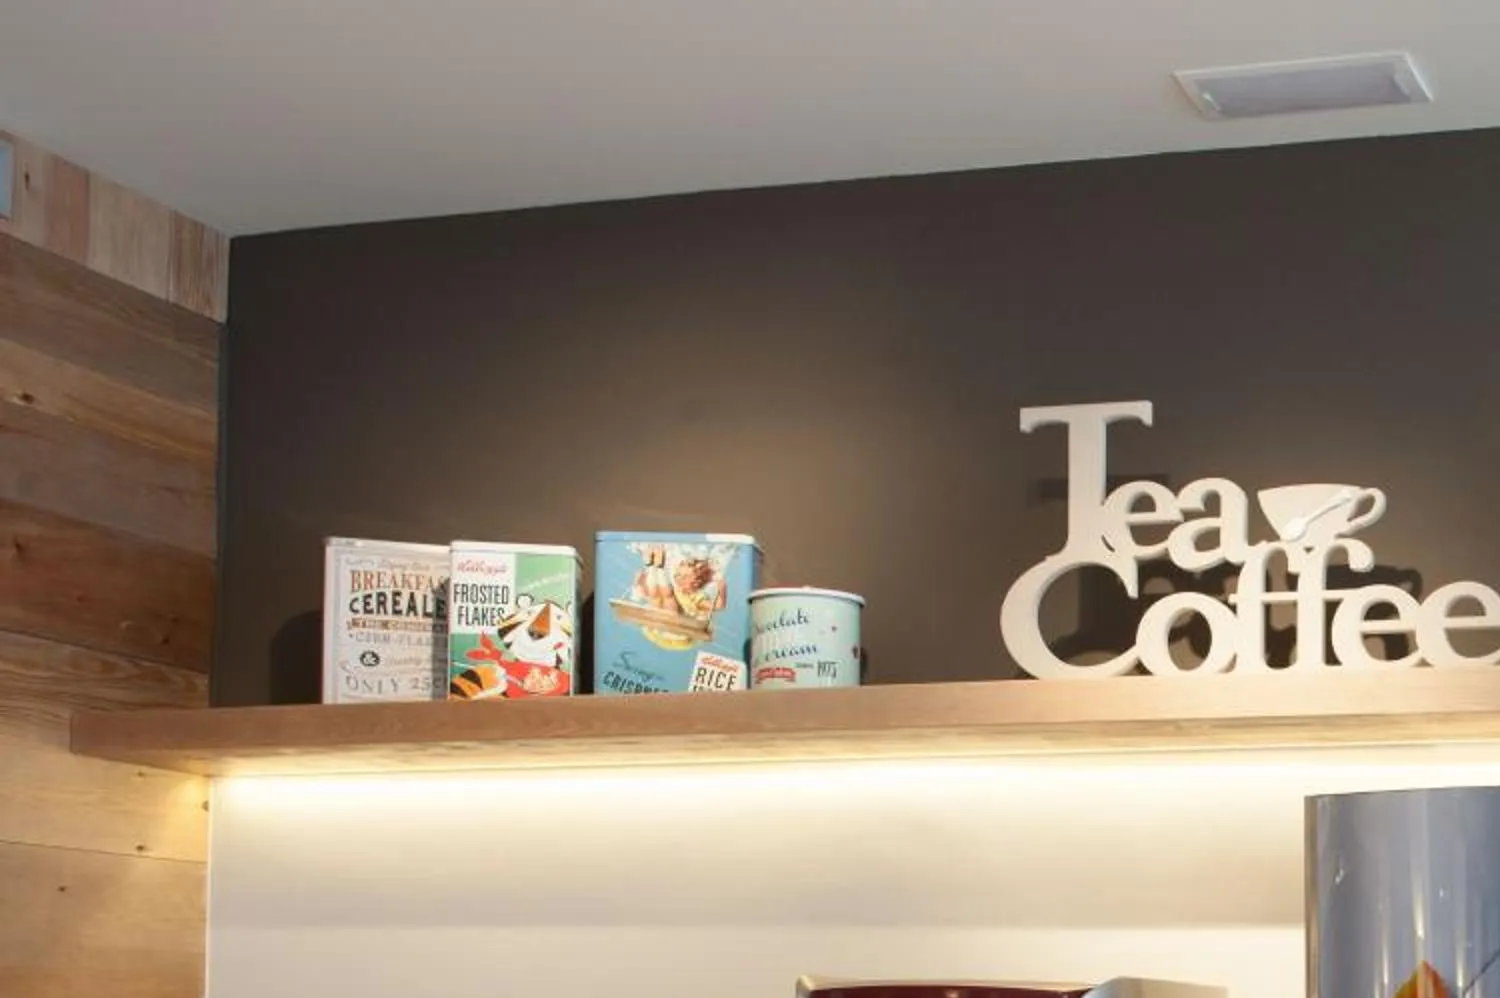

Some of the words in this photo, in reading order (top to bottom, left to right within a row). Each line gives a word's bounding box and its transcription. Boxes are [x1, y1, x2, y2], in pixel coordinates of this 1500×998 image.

[1020, 400, 1250, 572] Tea
[453, 583, 510, 605] FROSTED
[457, 605, 505, 627] FLAKES
[695, 667, 737, 691] RICE
